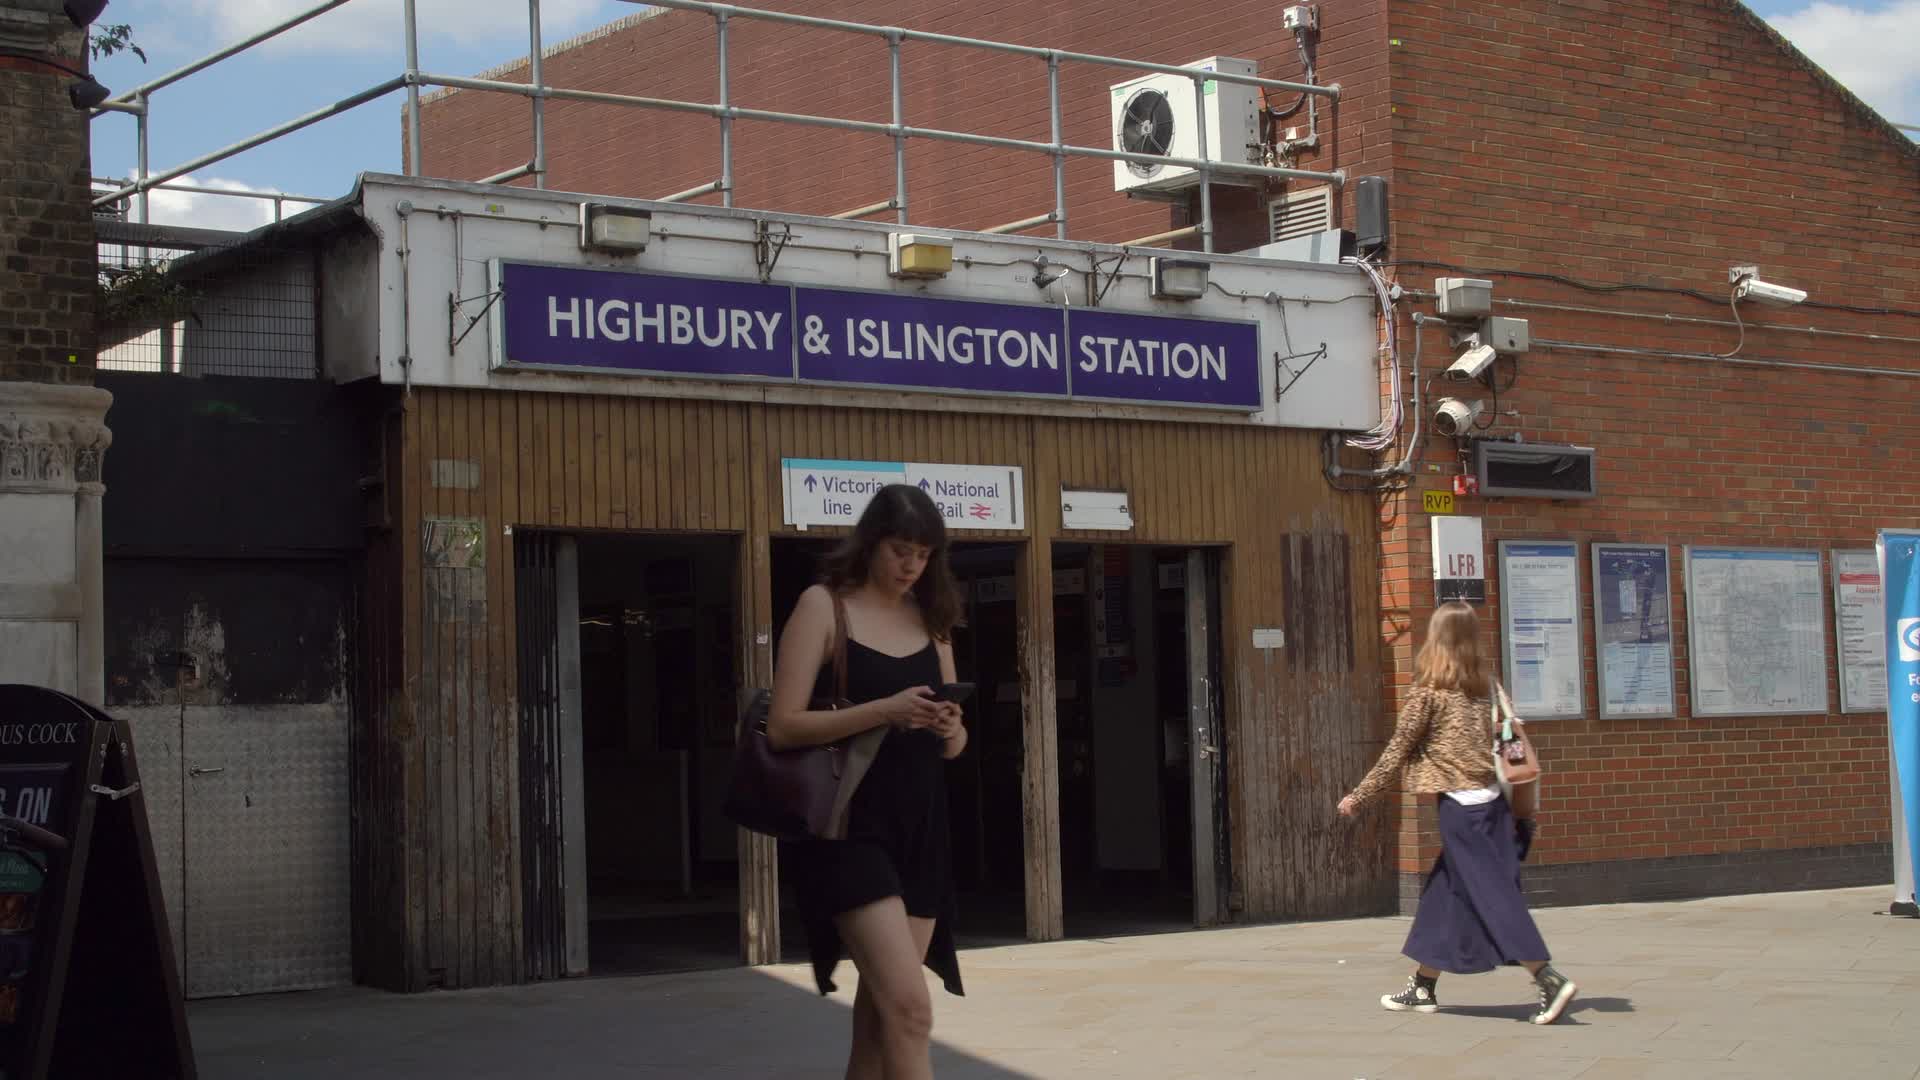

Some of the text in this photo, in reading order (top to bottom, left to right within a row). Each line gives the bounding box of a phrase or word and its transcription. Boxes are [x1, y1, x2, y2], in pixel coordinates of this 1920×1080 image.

[548, 296, 1227, 380] HIGHBURY & ISLINGTON STATION
[822, 476, 884, 493] Victoria
[935, 479, 999, 498] National
[823, 498, 852, 515] line
[936, 501, 964, 518] Rail
[1425, 494, 1451, 509] RVP
[0, 722, 77, 745] US COCK
[16, 787, 53, 824] ON
